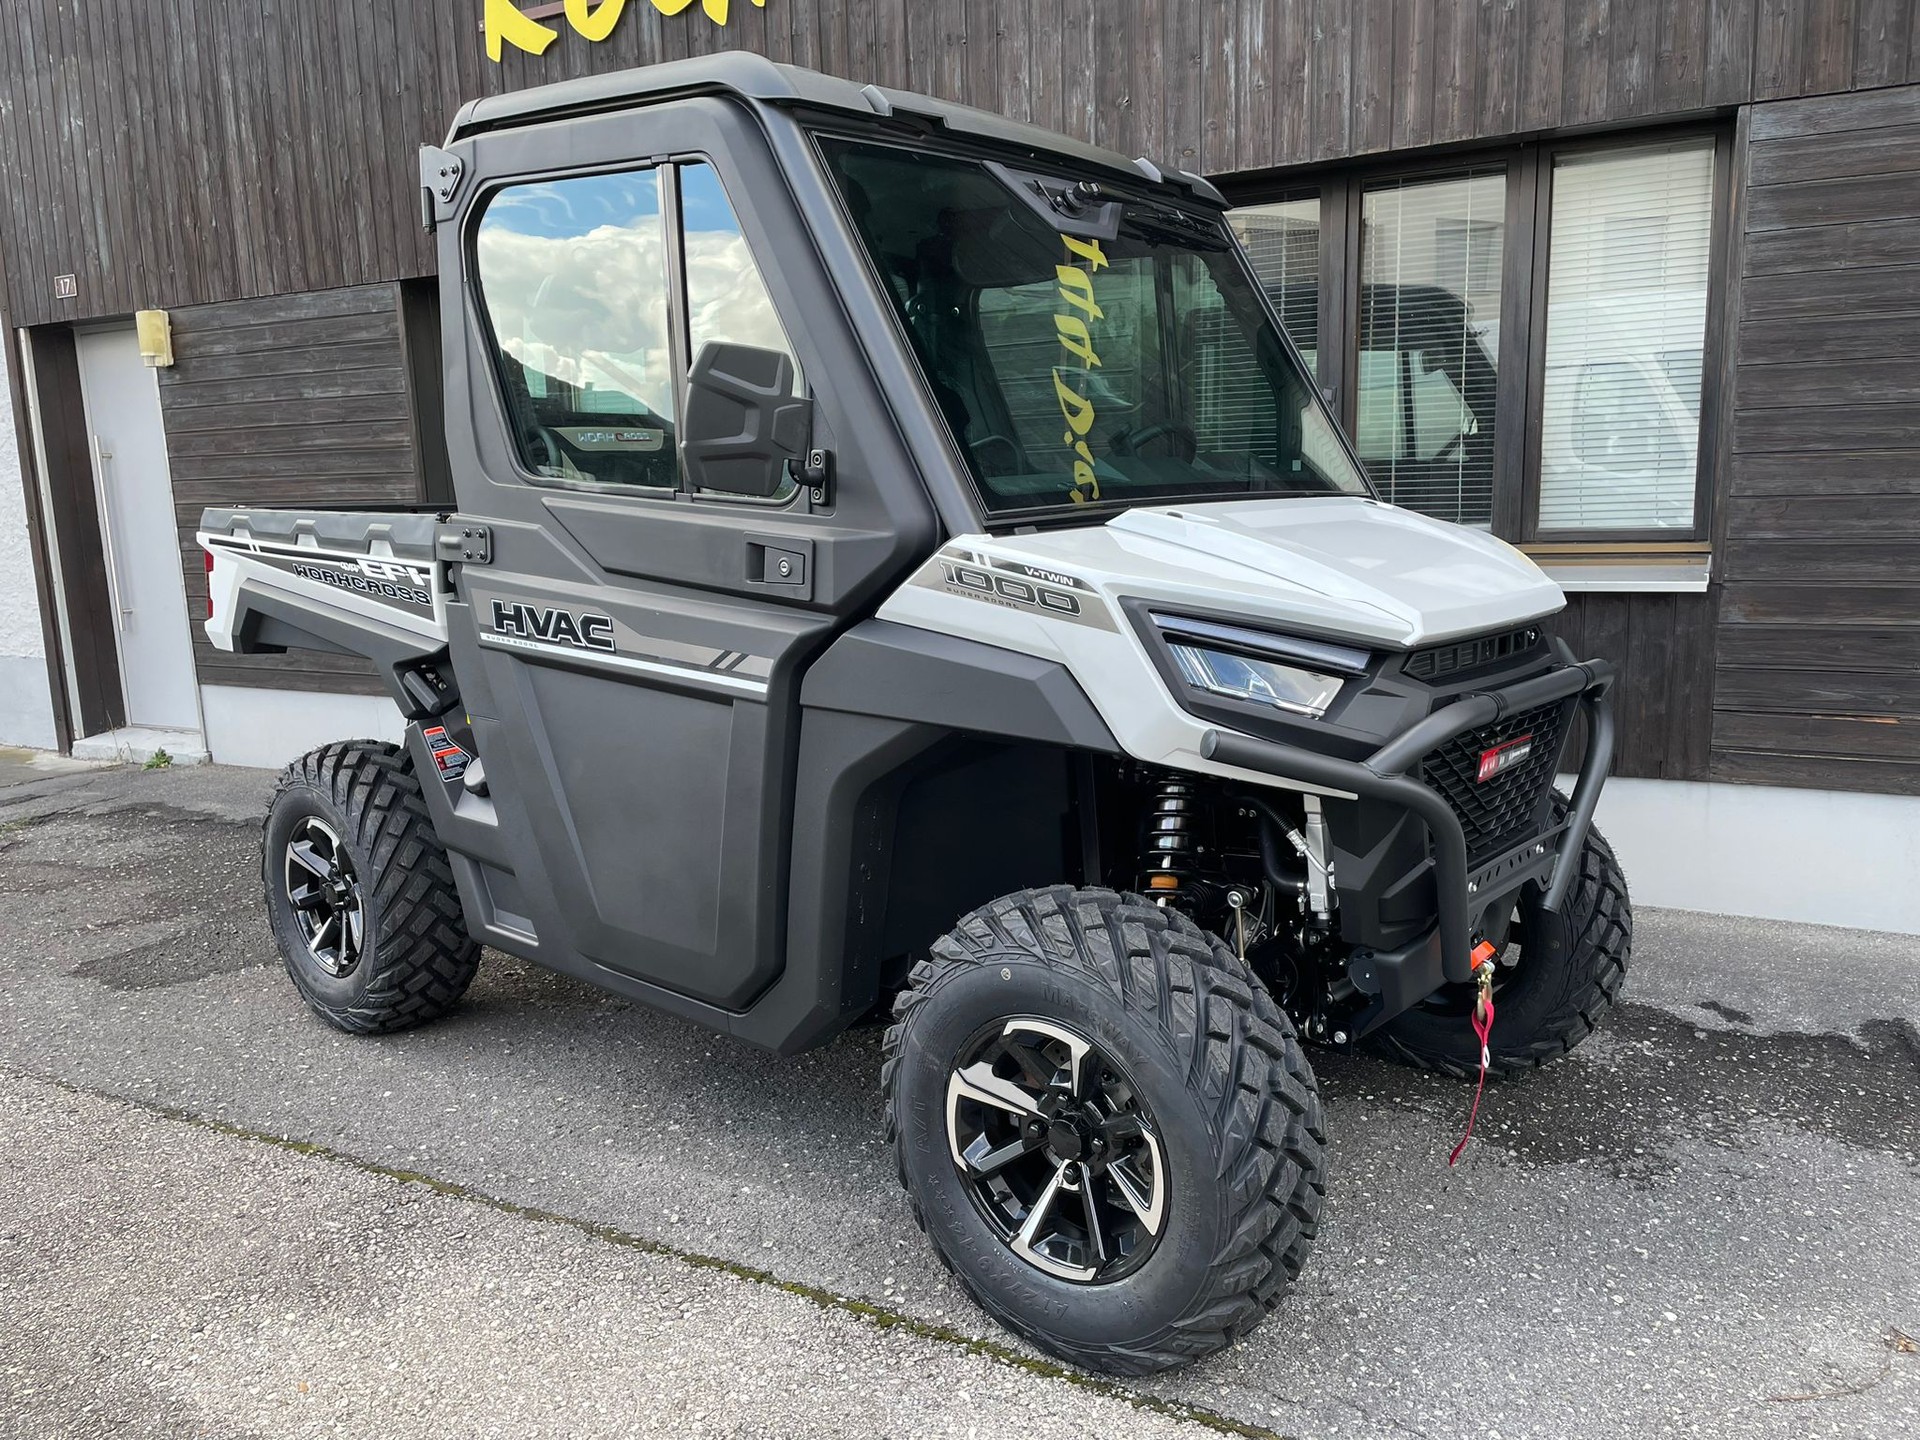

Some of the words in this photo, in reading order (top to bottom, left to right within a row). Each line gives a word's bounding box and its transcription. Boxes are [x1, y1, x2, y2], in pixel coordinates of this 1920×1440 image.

[60, 278, 71, 295] 17
[292, 563, 432, 607] WORKCROSS
[939, 561, 1081, 617] 1000
[1023, 566, 1074, 586] V-TWIN
[490, 598, 617, 654] HVAC
